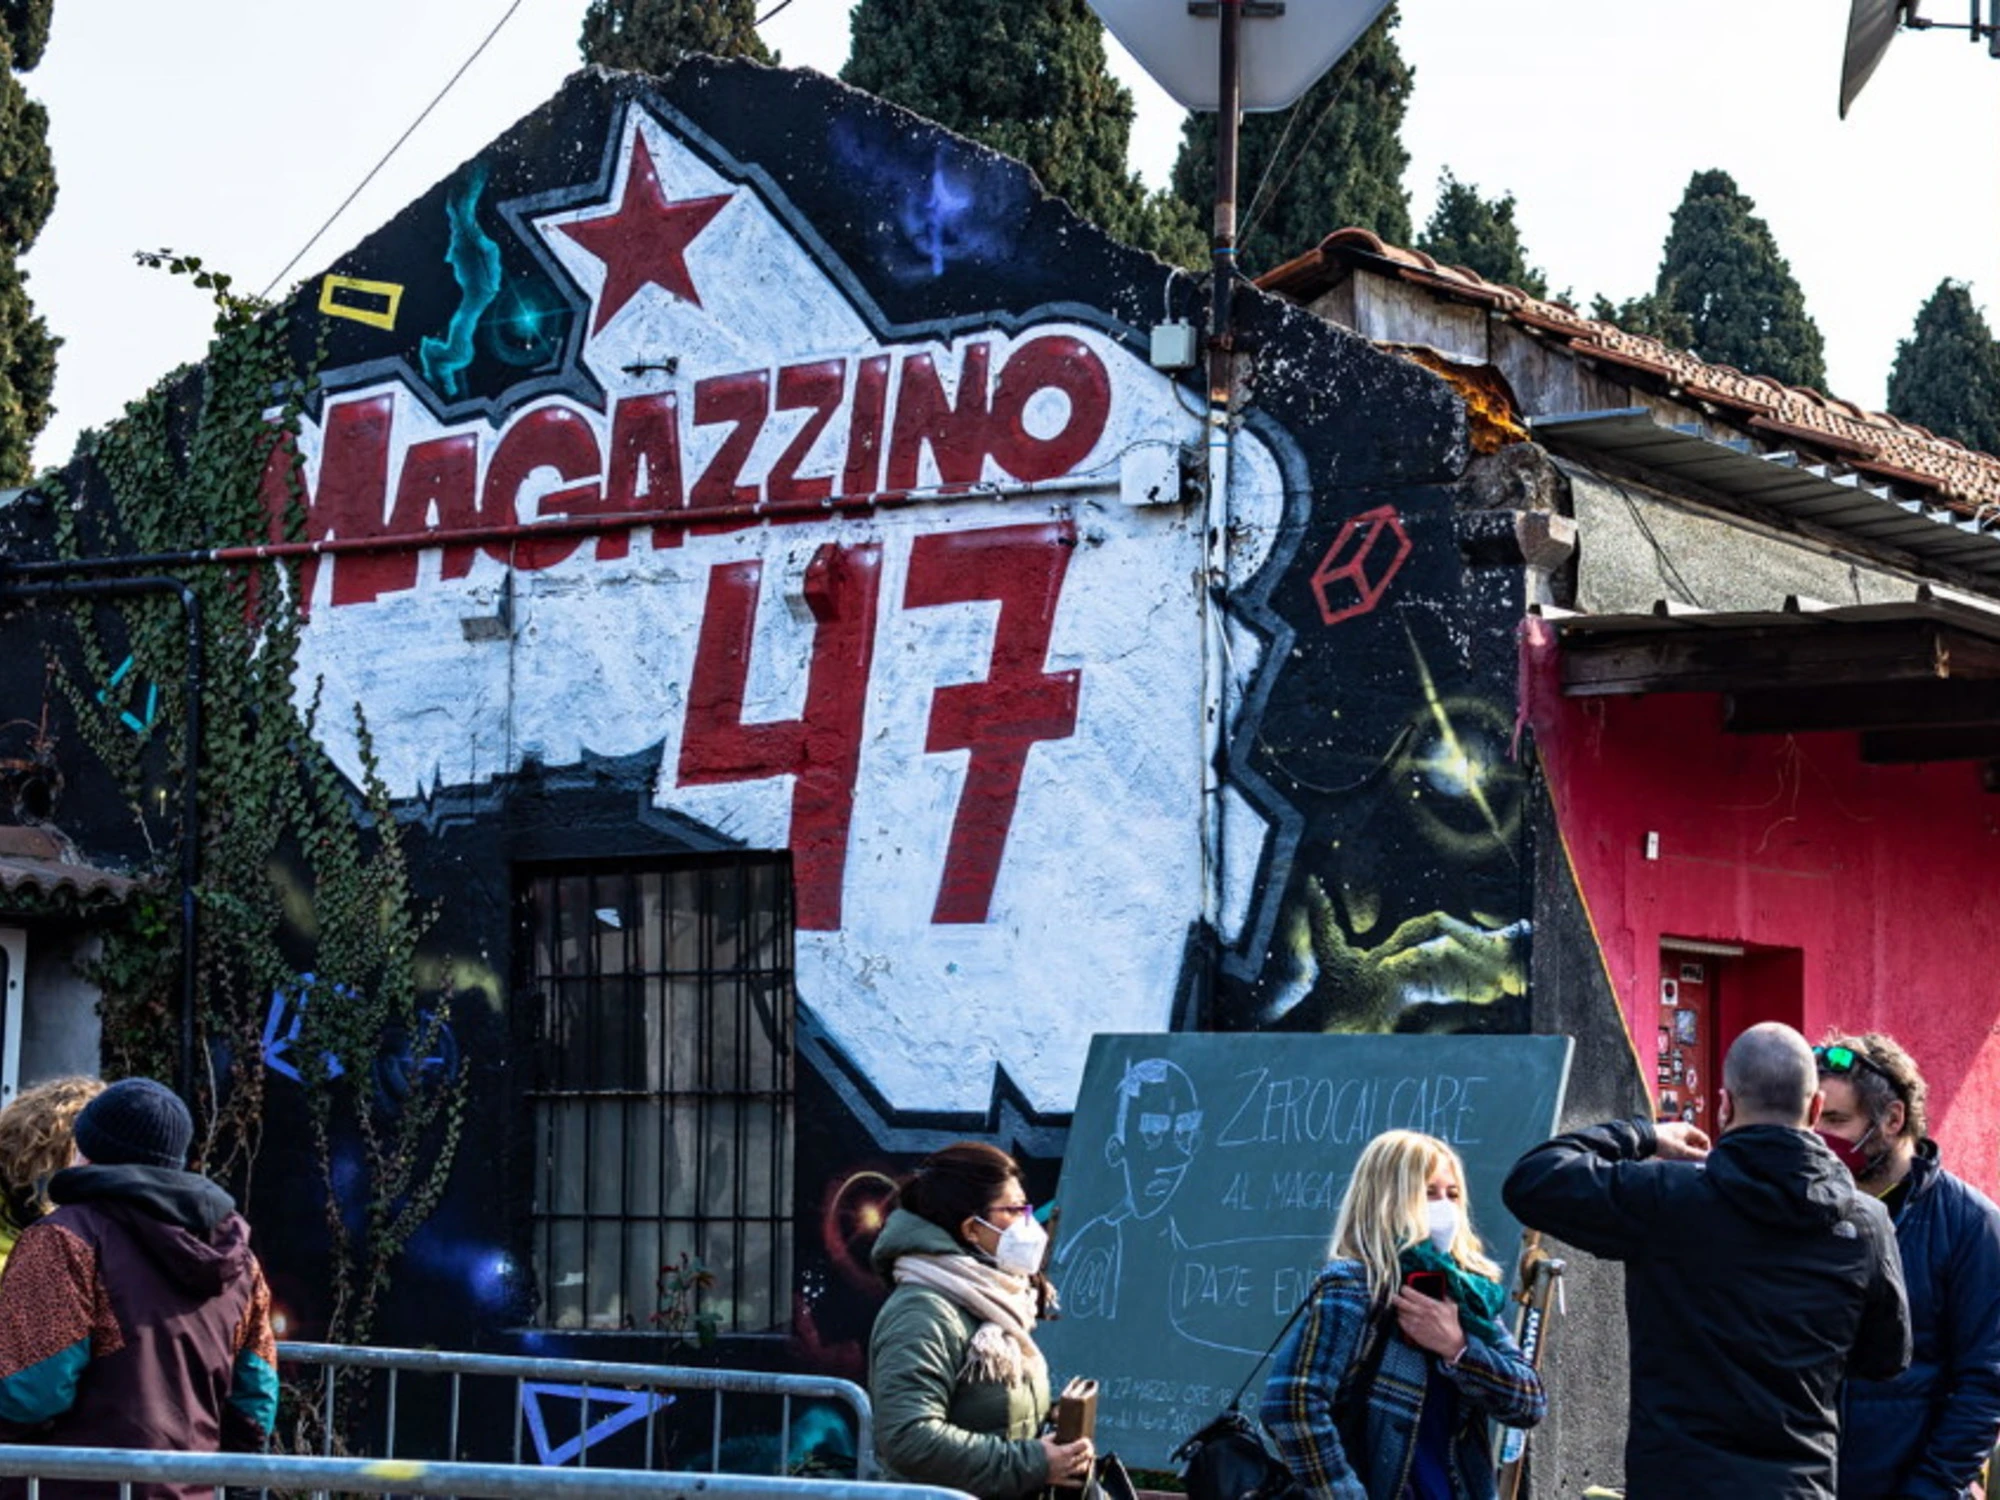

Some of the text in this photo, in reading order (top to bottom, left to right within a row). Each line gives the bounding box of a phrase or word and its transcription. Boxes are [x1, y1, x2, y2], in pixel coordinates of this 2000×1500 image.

[246, 334, 1112, 622] MAGAZZINO
[677, 520, 1082, 931] 47
[1221, 1171, 1252, 1211] AL
